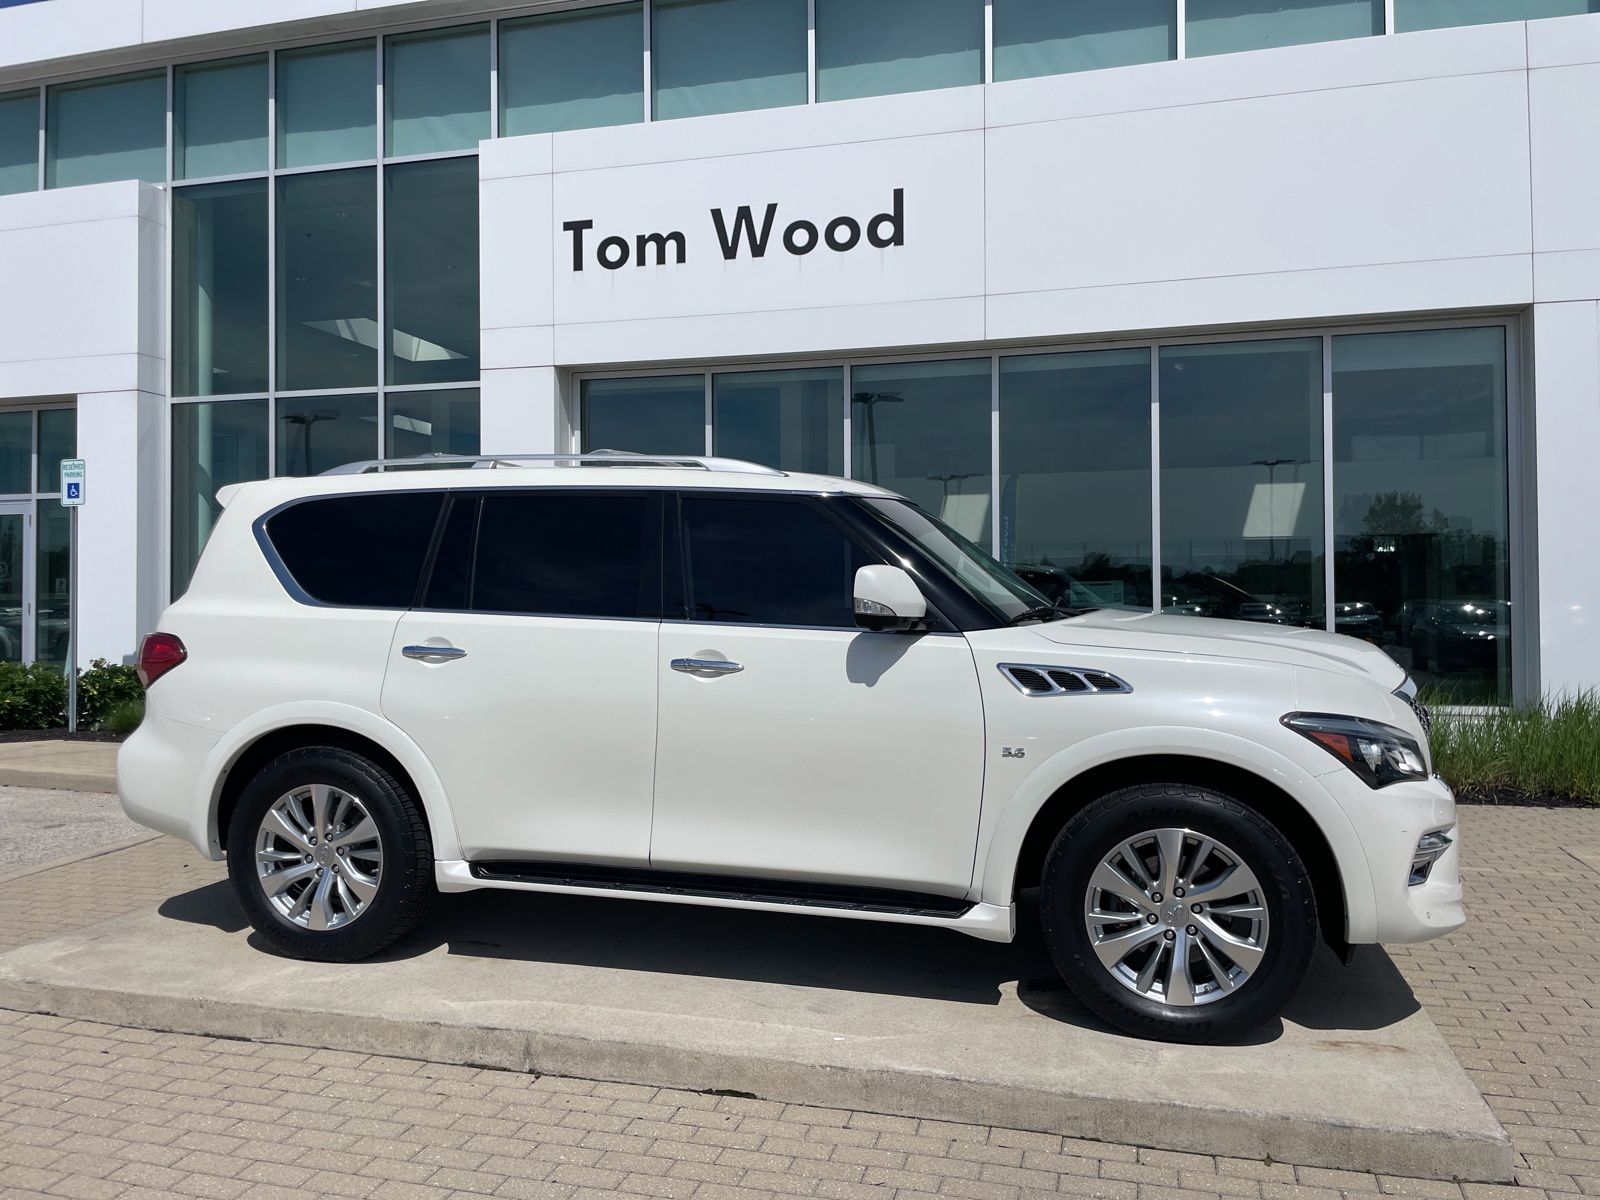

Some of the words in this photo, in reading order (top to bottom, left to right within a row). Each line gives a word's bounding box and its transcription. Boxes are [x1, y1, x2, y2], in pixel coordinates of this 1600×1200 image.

[562, 219, 686, 272] Tom
[710, 187, 904, 260] Wood
[64, 471, 82, 479] PARKING
[1002, 746, 1025, 758] 5.6
